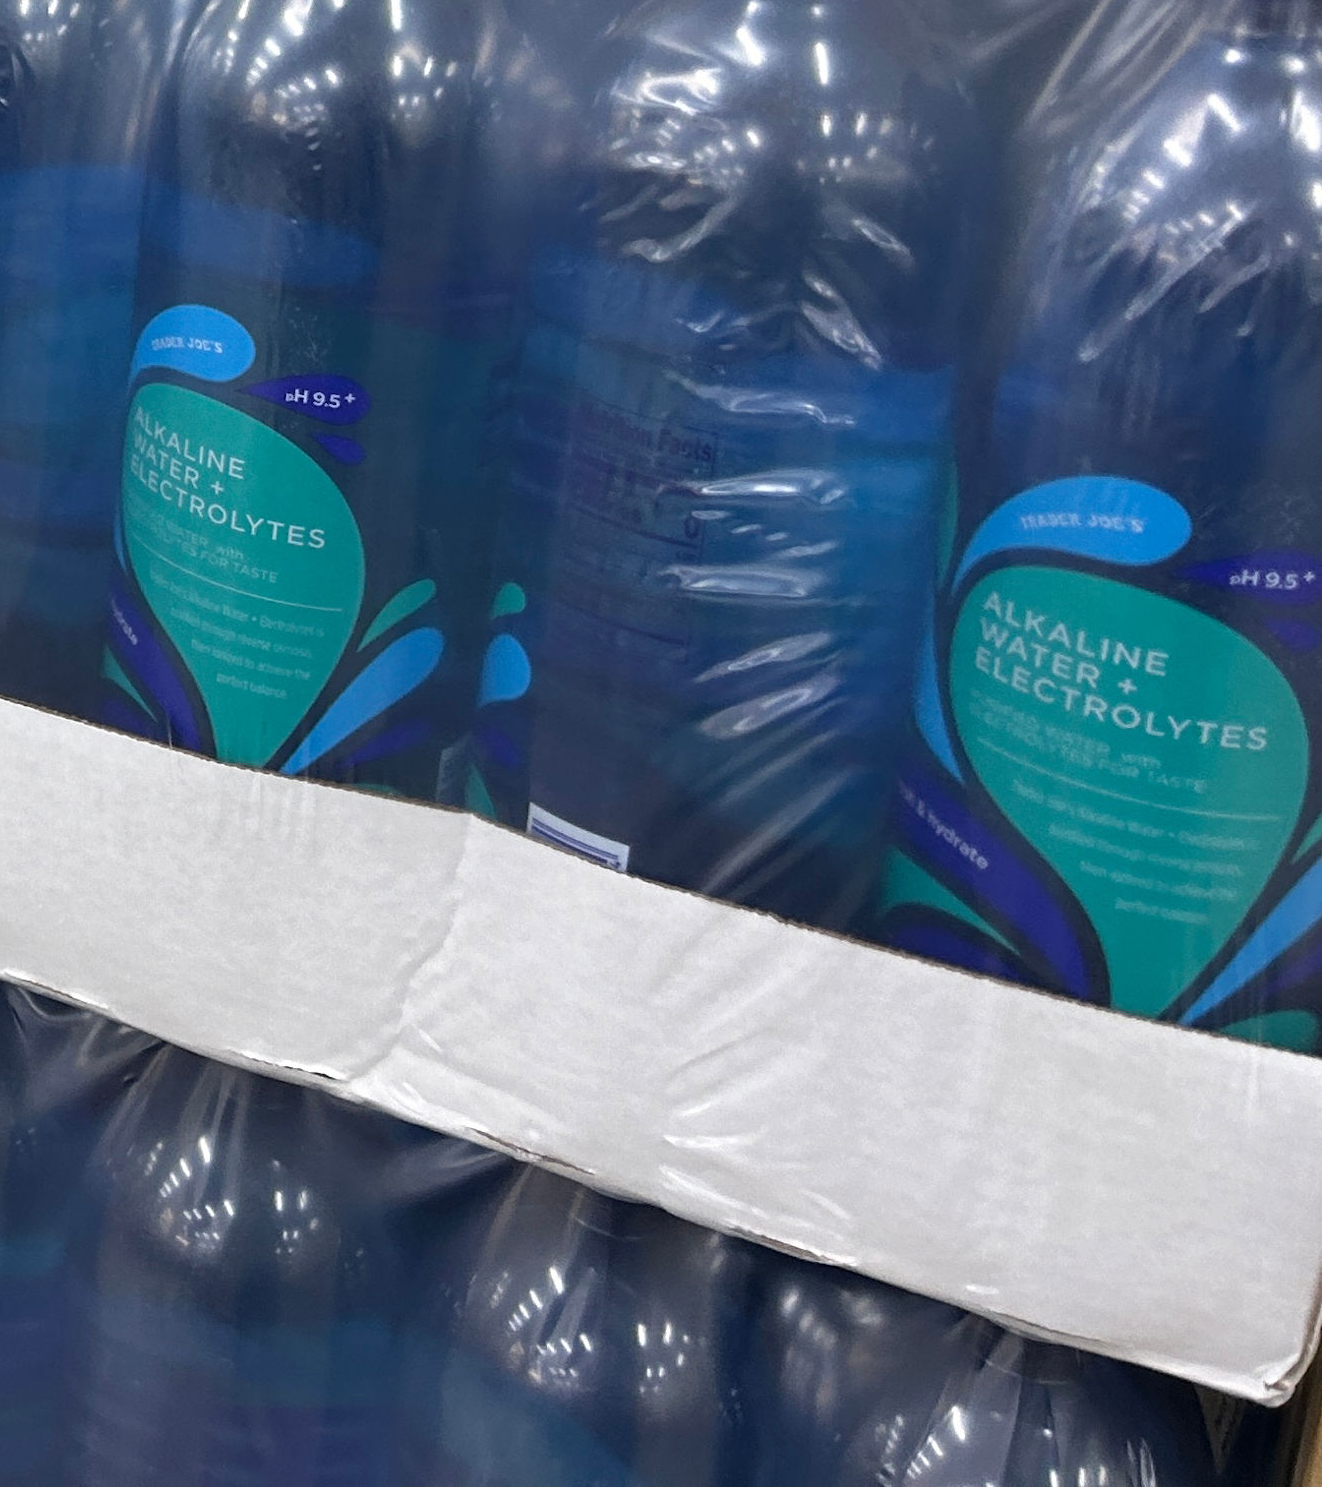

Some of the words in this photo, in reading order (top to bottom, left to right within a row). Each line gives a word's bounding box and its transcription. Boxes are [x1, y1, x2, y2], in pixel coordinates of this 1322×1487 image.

[285, 388, 308, 404] pH
[133, 405, 246, 480] ALKALINE
[133, 429, 200, 489] WATER
[210, 481, 225, 496] +
[131, 454, 326, 549] ELECTROLYTES
[1229, 568, 1259, 586] pH
[979, 616, 1101, 689] WATER
[1117, 677, 1138, 695] +
[982, 589, 1170, 677] ALKALINE
[974, 645, 1269, 752] ELECTROLYTES
